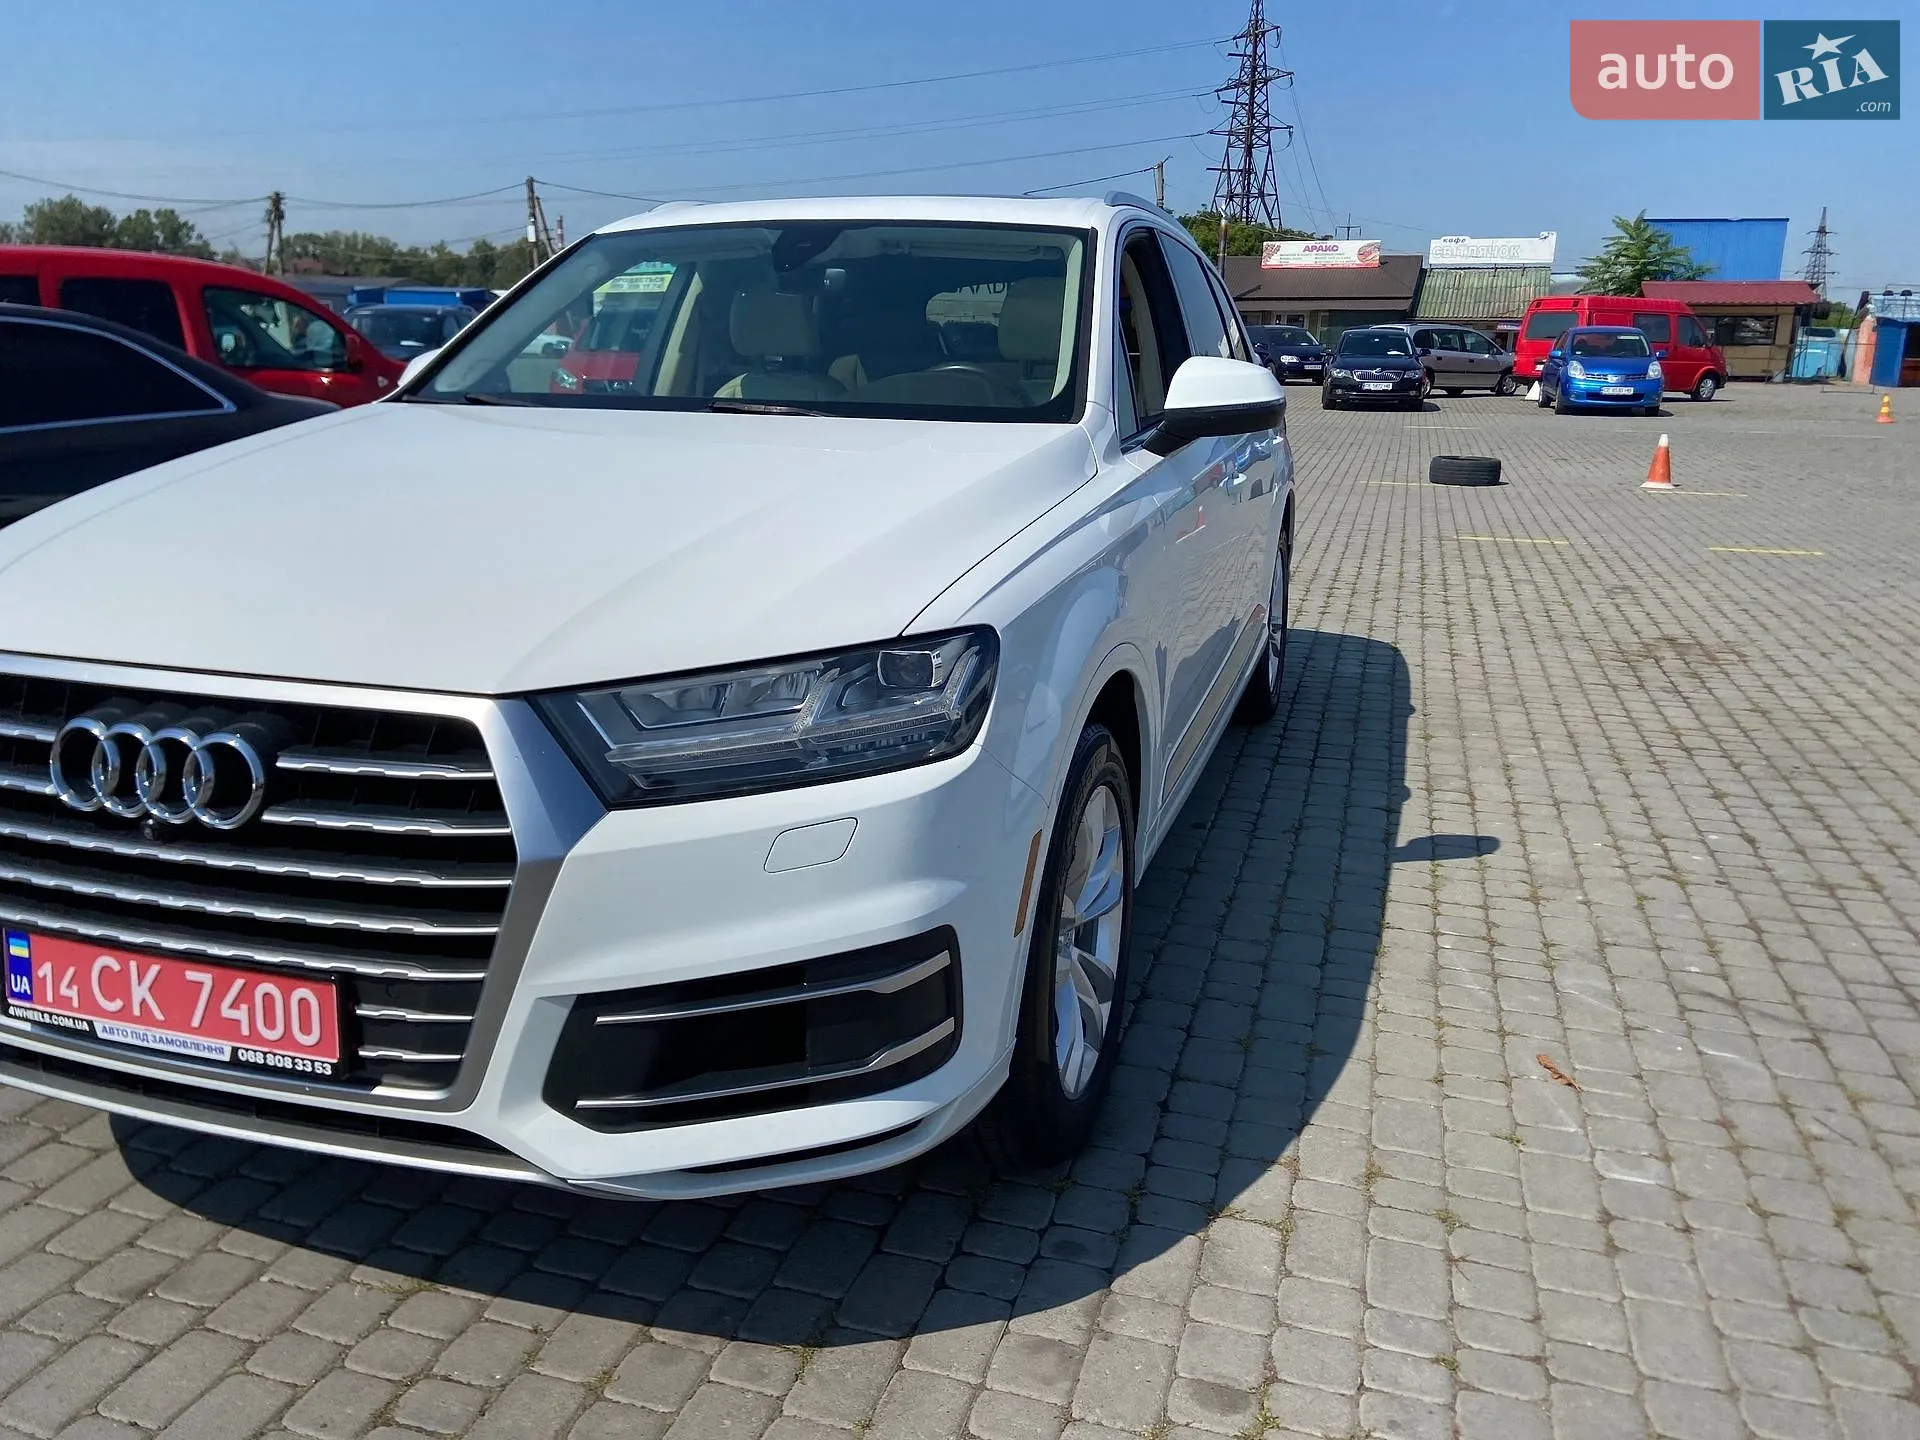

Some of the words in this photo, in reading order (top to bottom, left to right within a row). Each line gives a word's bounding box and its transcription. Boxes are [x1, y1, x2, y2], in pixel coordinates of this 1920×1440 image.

[10, 973, 31, 996] UA
[37, 961, 79, 1009] 14
[90, 955, 165, 1021] CK
[184, 970, 322, 1047] 7400
[101, 1024, 129, 1039] АВТО
[130, 1031, 150, 1043] ПІД
[151, 1036, 225, 1056] ЗАМОВЛЕННЯ
[294, 1058, 313, 1073] 33
[314, 1061, 332, 1076] 53
